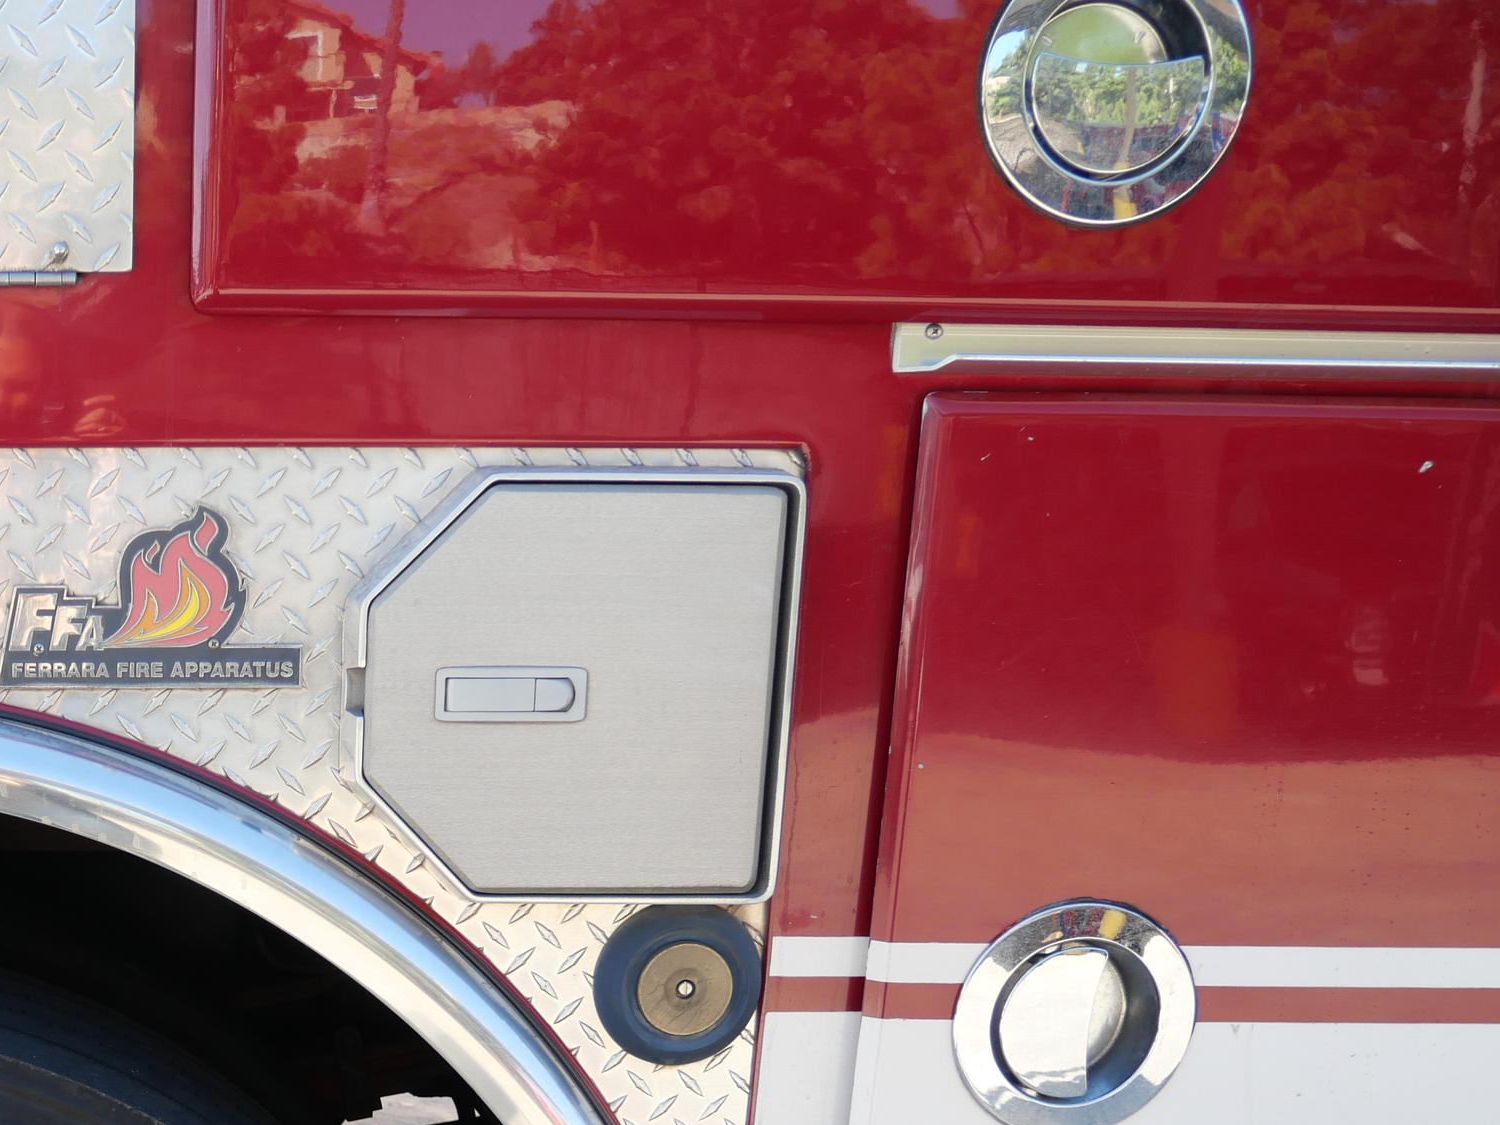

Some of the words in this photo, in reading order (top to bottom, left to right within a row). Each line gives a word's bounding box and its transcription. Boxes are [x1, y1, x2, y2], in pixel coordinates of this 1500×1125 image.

[11, 661, 110, 679] FERRARA
[116, 661, 164, 678] FIRE
[170, 661, 294, 678] APPARATUS
